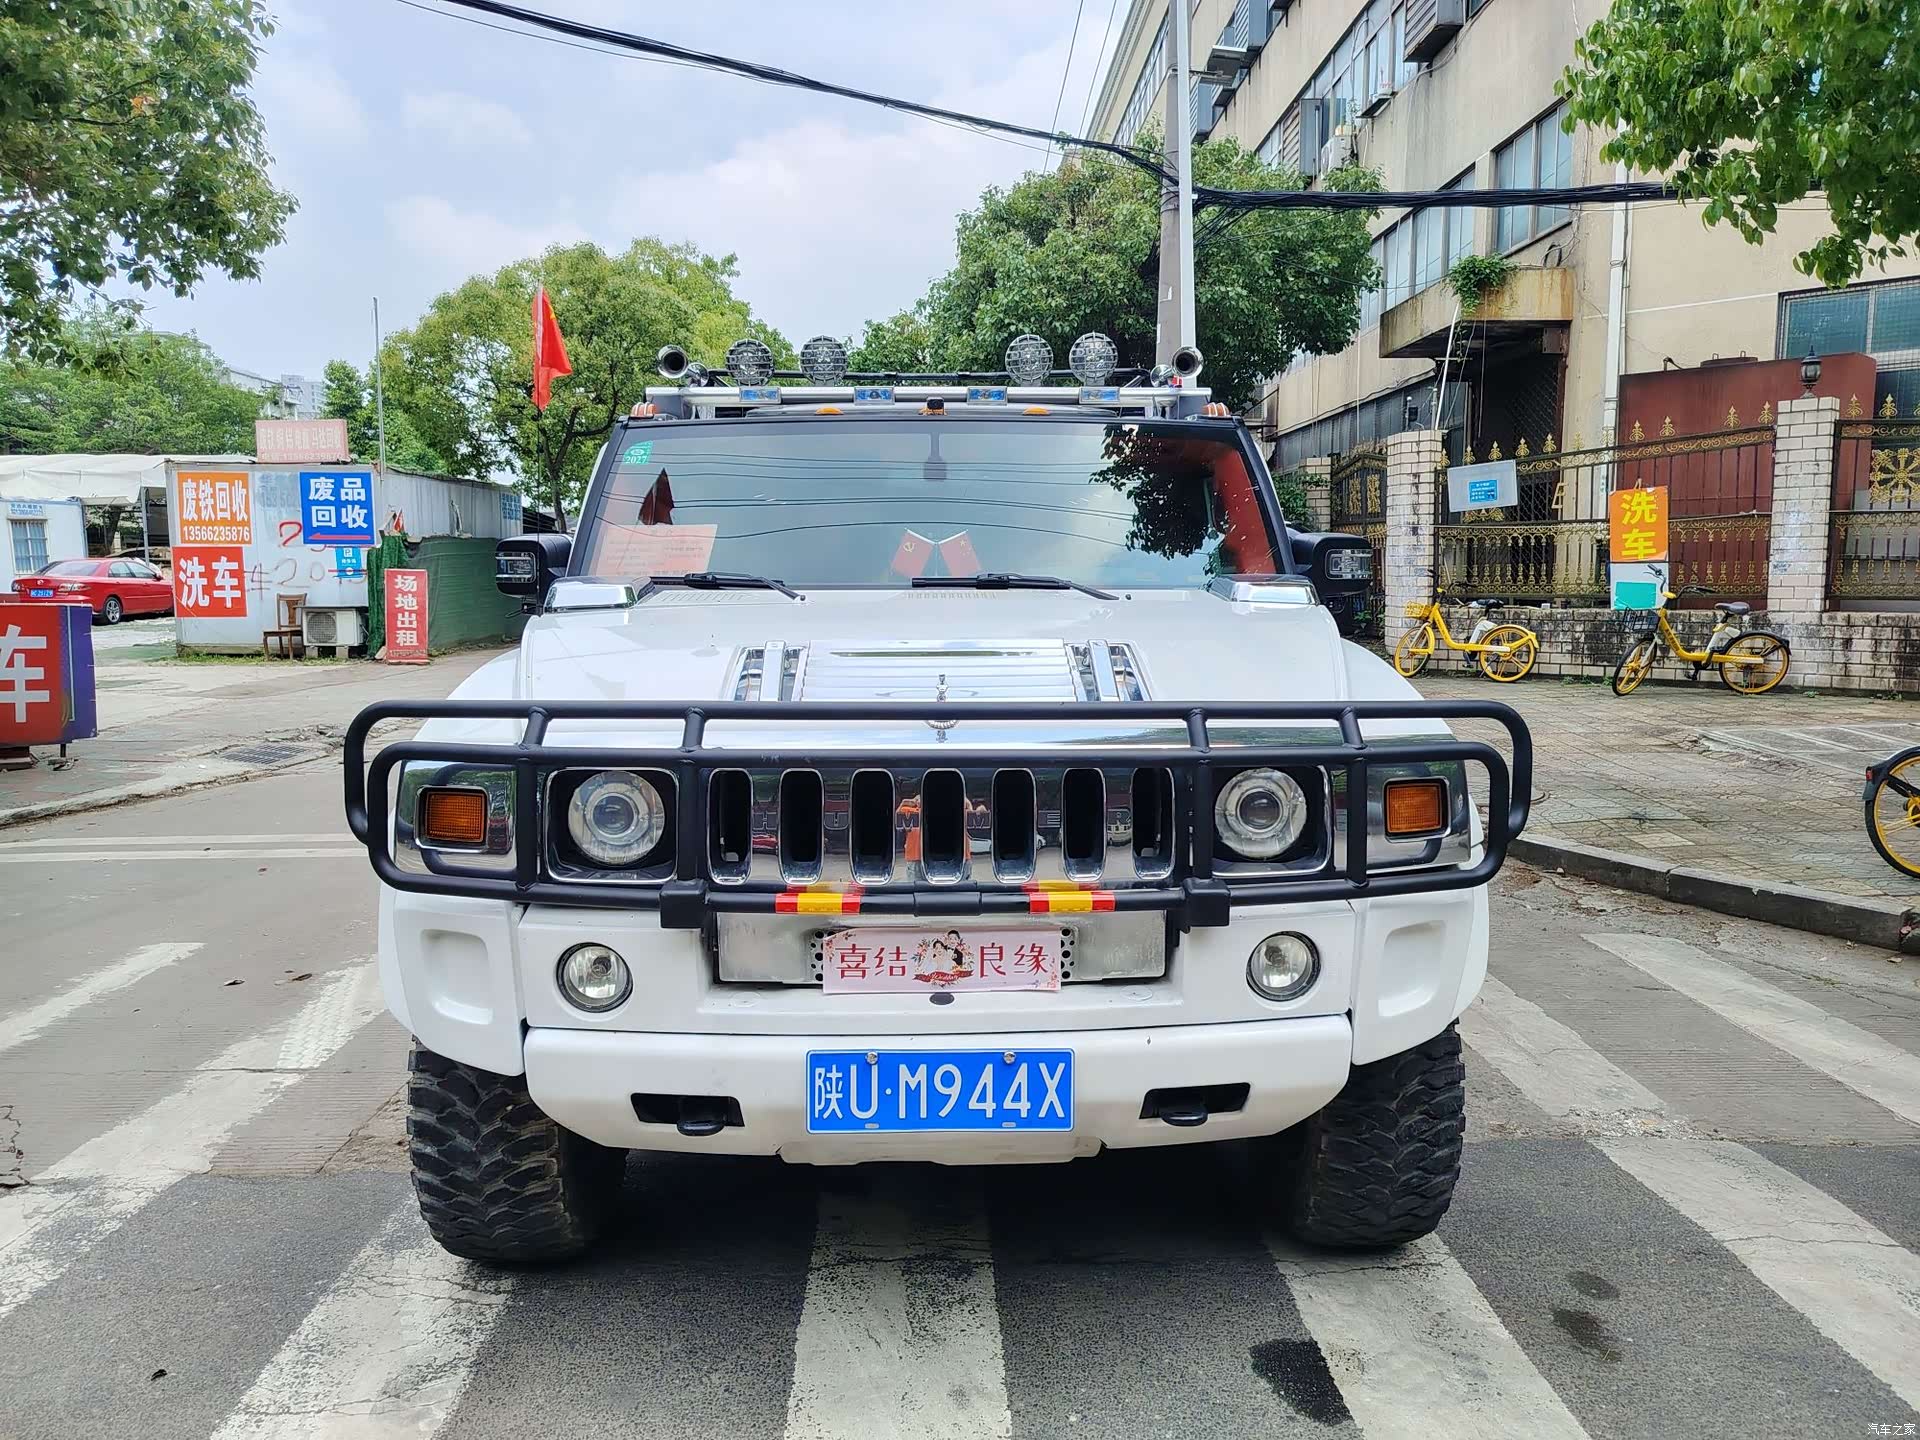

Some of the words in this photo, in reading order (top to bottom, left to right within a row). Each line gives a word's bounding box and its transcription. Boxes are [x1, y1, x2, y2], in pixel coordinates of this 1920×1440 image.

[625, 456, 647, 464] 2027
[182, 478, 249, 522] 废铁回收
[309, 477, 367, 501] 废品
[183, 525, 250, 542] 13566235876
[311, 505, 368, 529] 回收
[1620, 491, 1658, 560] 洗车
[178, 556, 241, 609] 洗车
[394, 574, 419, 647] 场地出租
[0, 624, 50, 723] 车
[835, 943, 909, 980] 喜结
[979, 941, 1049, 979] 良缘
[814, 1062, 1066, 1120] 陕U·M944X
